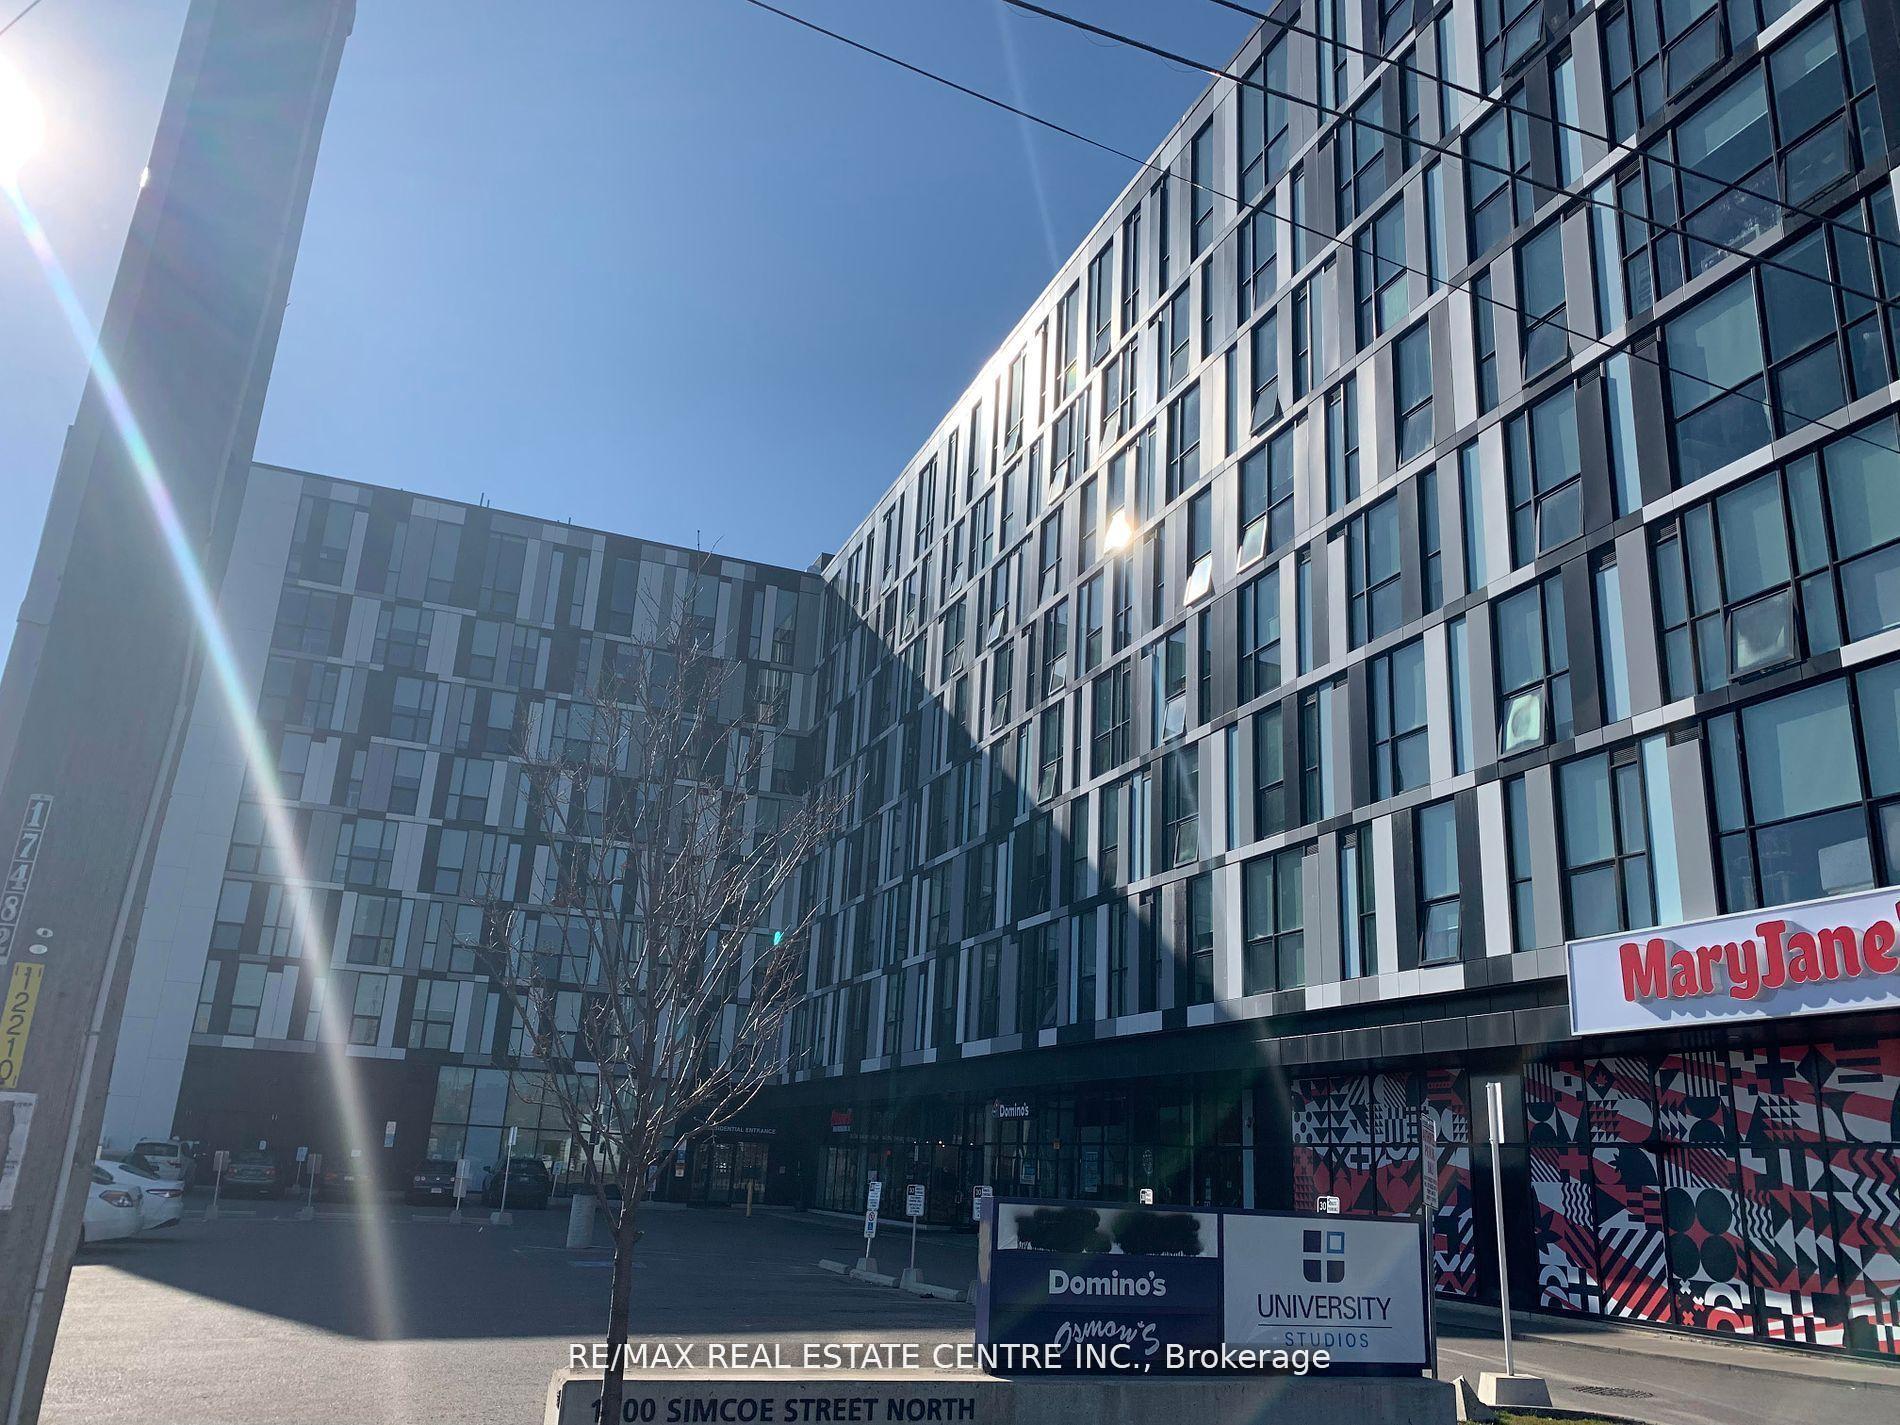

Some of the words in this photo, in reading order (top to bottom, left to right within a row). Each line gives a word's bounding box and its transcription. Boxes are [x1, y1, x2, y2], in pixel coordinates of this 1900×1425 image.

[1000, 1102, 1029, 1118] Domino's
[1319, 1201, 1327, 1211] 30
[1049, 1268, 1167, 1298] Domino's
[1257, 1292, 1392, 1321] UNIVERSITY
[1285, 1331, 1370, 1349] STUDIOS
[592, 1397, 656, 1423] 100
[667, 1397, 774, 1423] SIMCOE
[784, 1397, 879, 1422] STREET
[886, 1397, 976, 1422] NORTH
